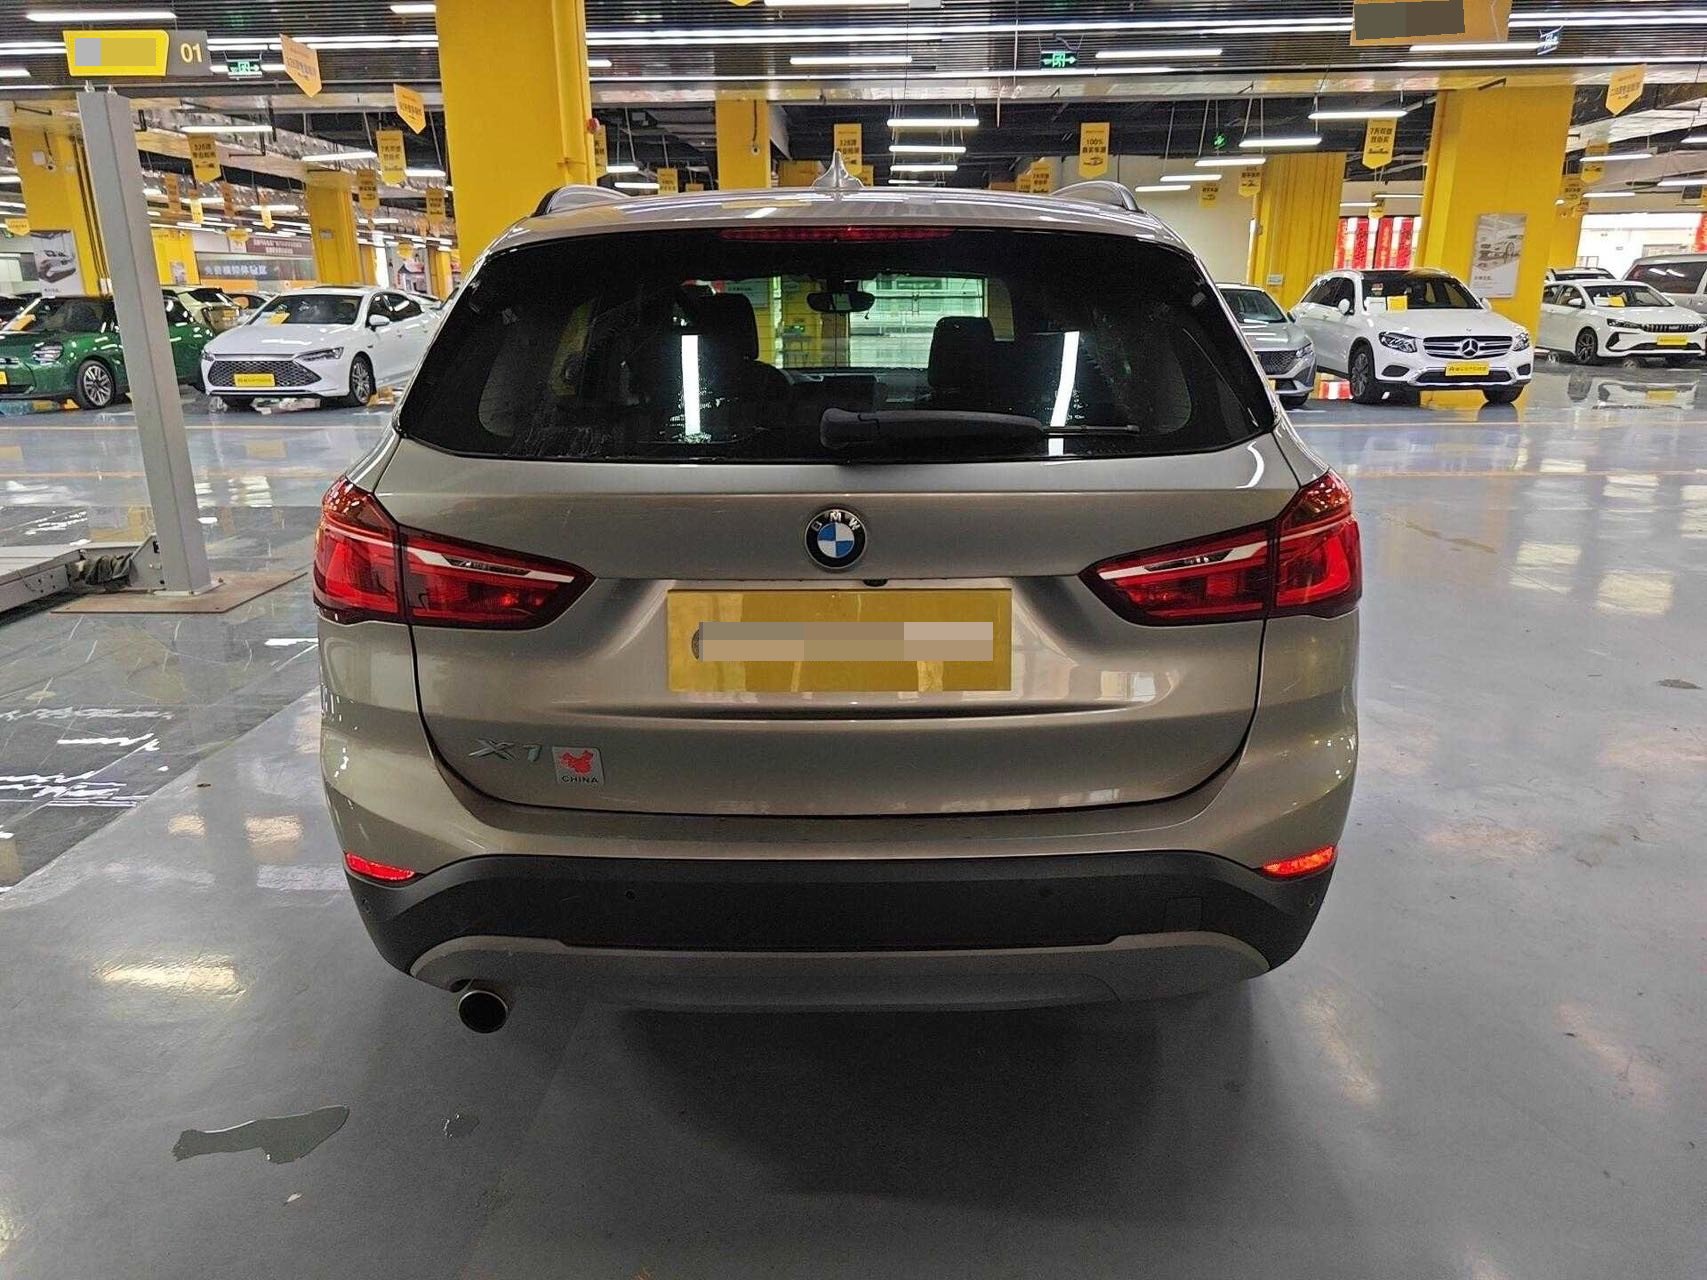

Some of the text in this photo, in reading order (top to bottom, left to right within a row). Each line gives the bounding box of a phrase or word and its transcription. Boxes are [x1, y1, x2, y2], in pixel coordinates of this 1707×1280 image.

[180, 43, 203, 64] 01
[811, 510, 861, 532] BMW
[468, 737, 542, 762] X1
[561, 774, 599, 785] CHINA
